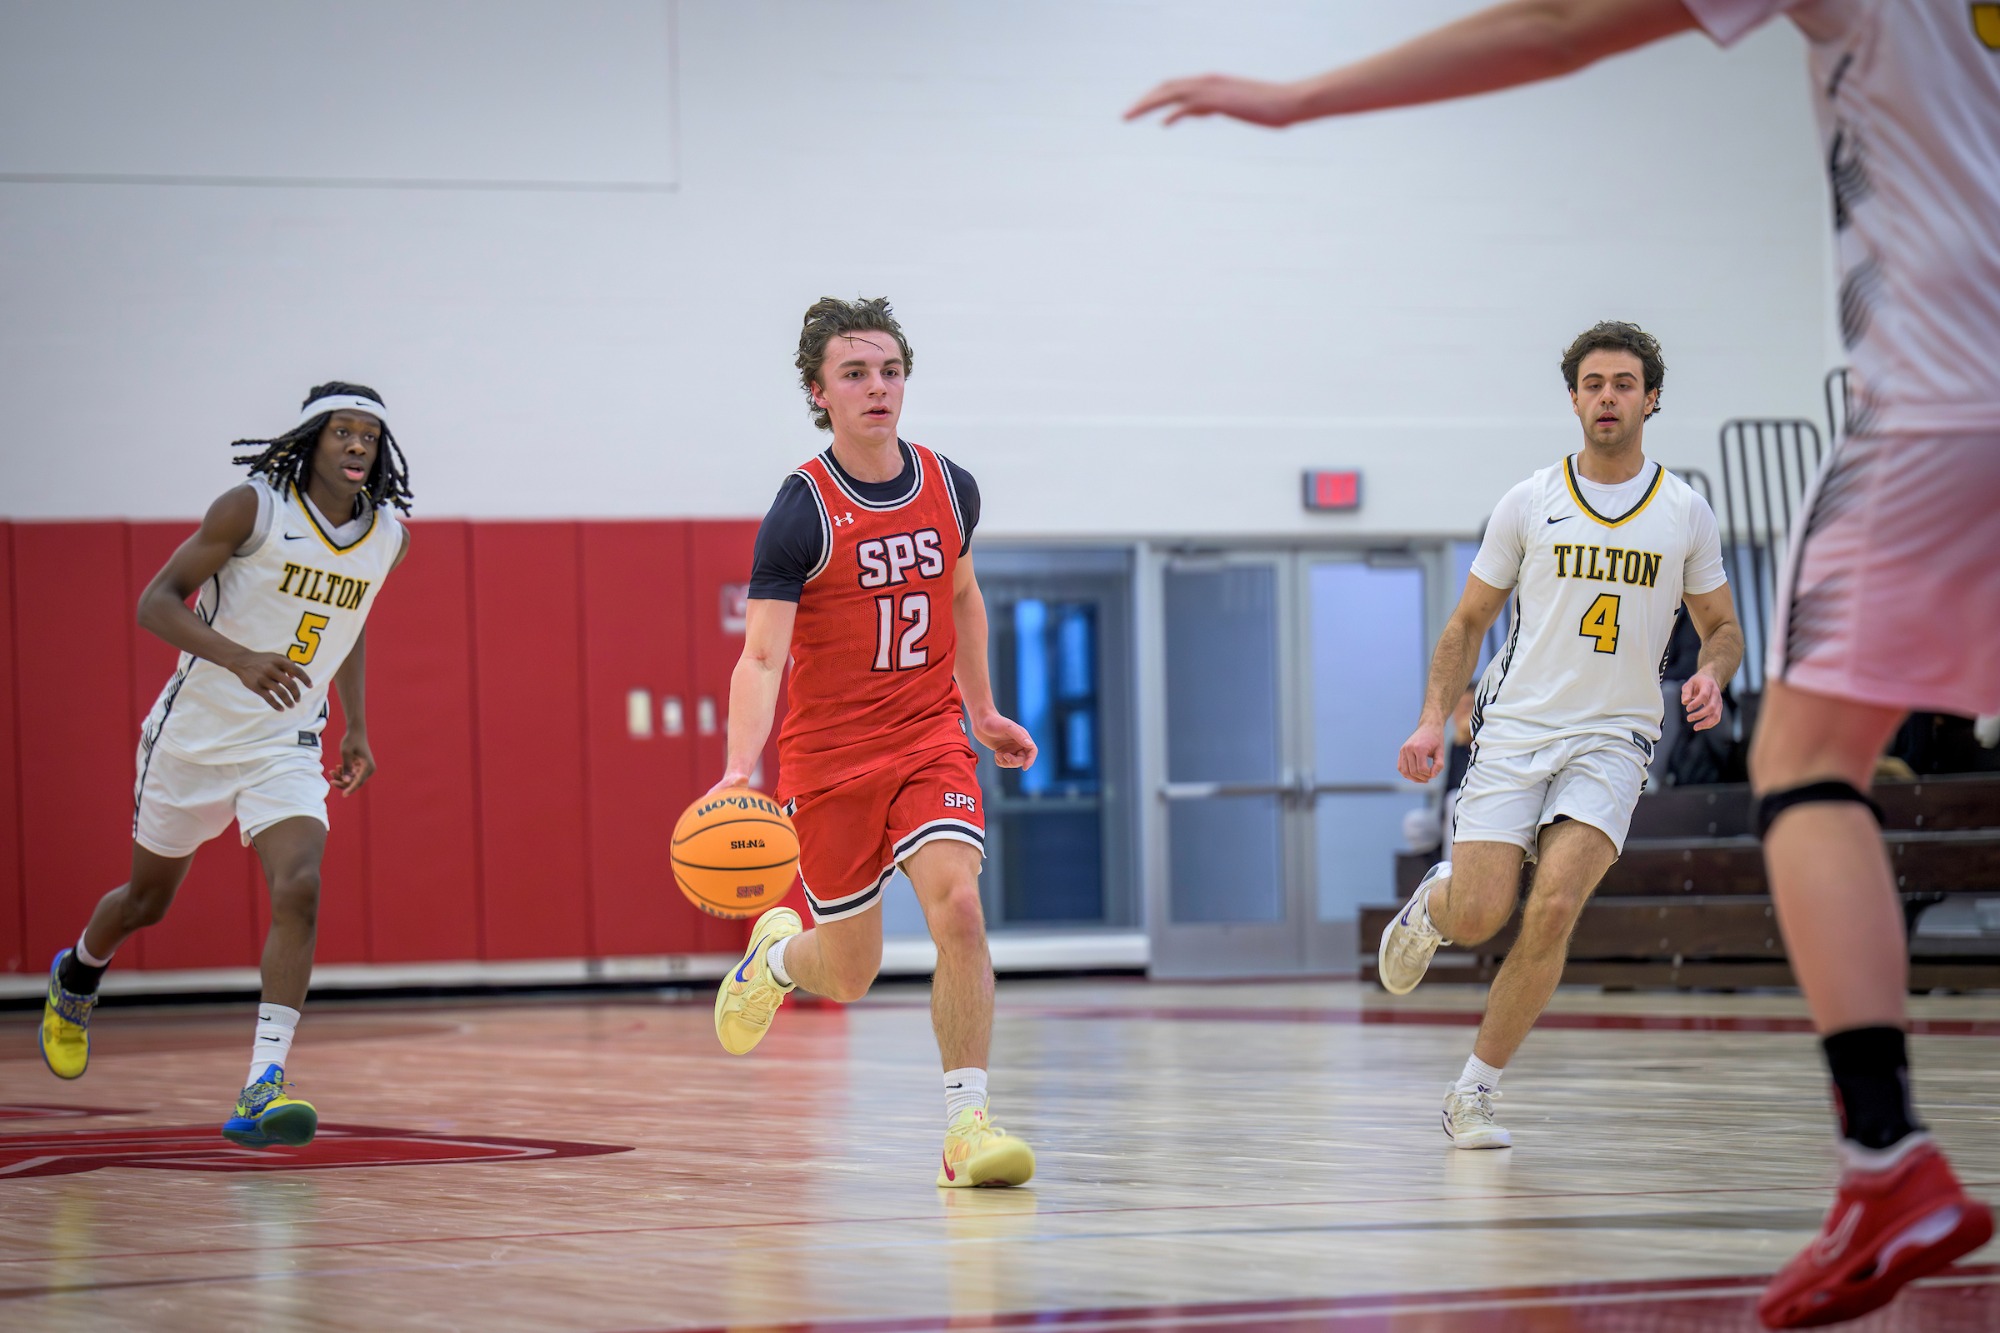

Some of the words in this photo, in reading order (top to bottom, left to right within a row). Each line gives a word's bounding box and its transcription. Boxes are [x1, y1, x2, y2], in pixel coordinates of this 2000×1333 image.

[857, 527, 945, 589] SPS
[1553, 544, 1663, 588] TILTON
[278, 562, 371, 611] TILTON
[286, 611, 330, 666] 5
[870, 591, 931, 672] 12
[1578, 592, 1621, 655] 4
[697, 795, 782, 819] Wilson
[943, 791, 977, 813] SPS
[730, 839, 758, 849] NFHS
